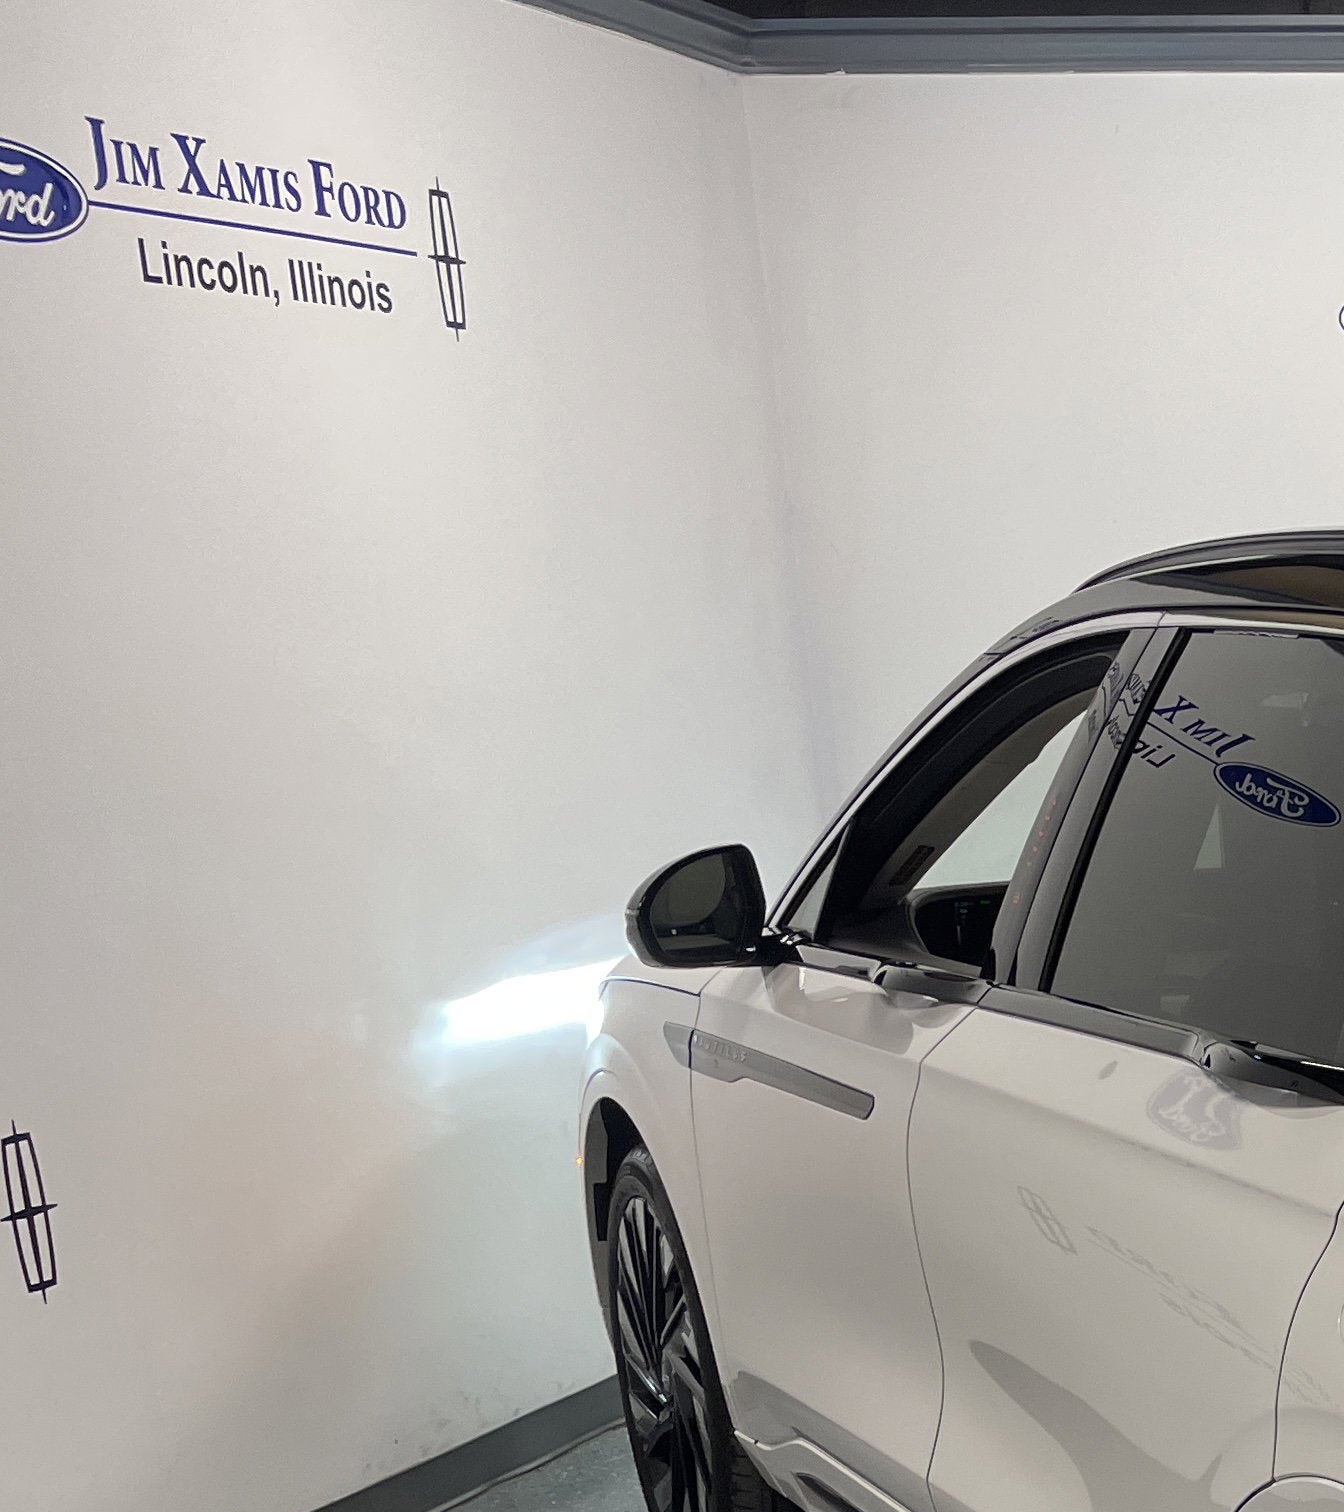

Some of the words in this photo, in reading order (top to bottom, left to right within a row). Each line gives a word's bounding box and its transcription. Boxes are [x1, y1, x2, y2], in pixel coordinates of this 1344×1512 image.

[84, 115, 165, 191] JIM
[170, 132, 302, 213] XAMIS
[307, 158, 407, 230] FORD
[137, 237, 281, 306] Lincoln,
[288, 258, 393, 314] Illinois
